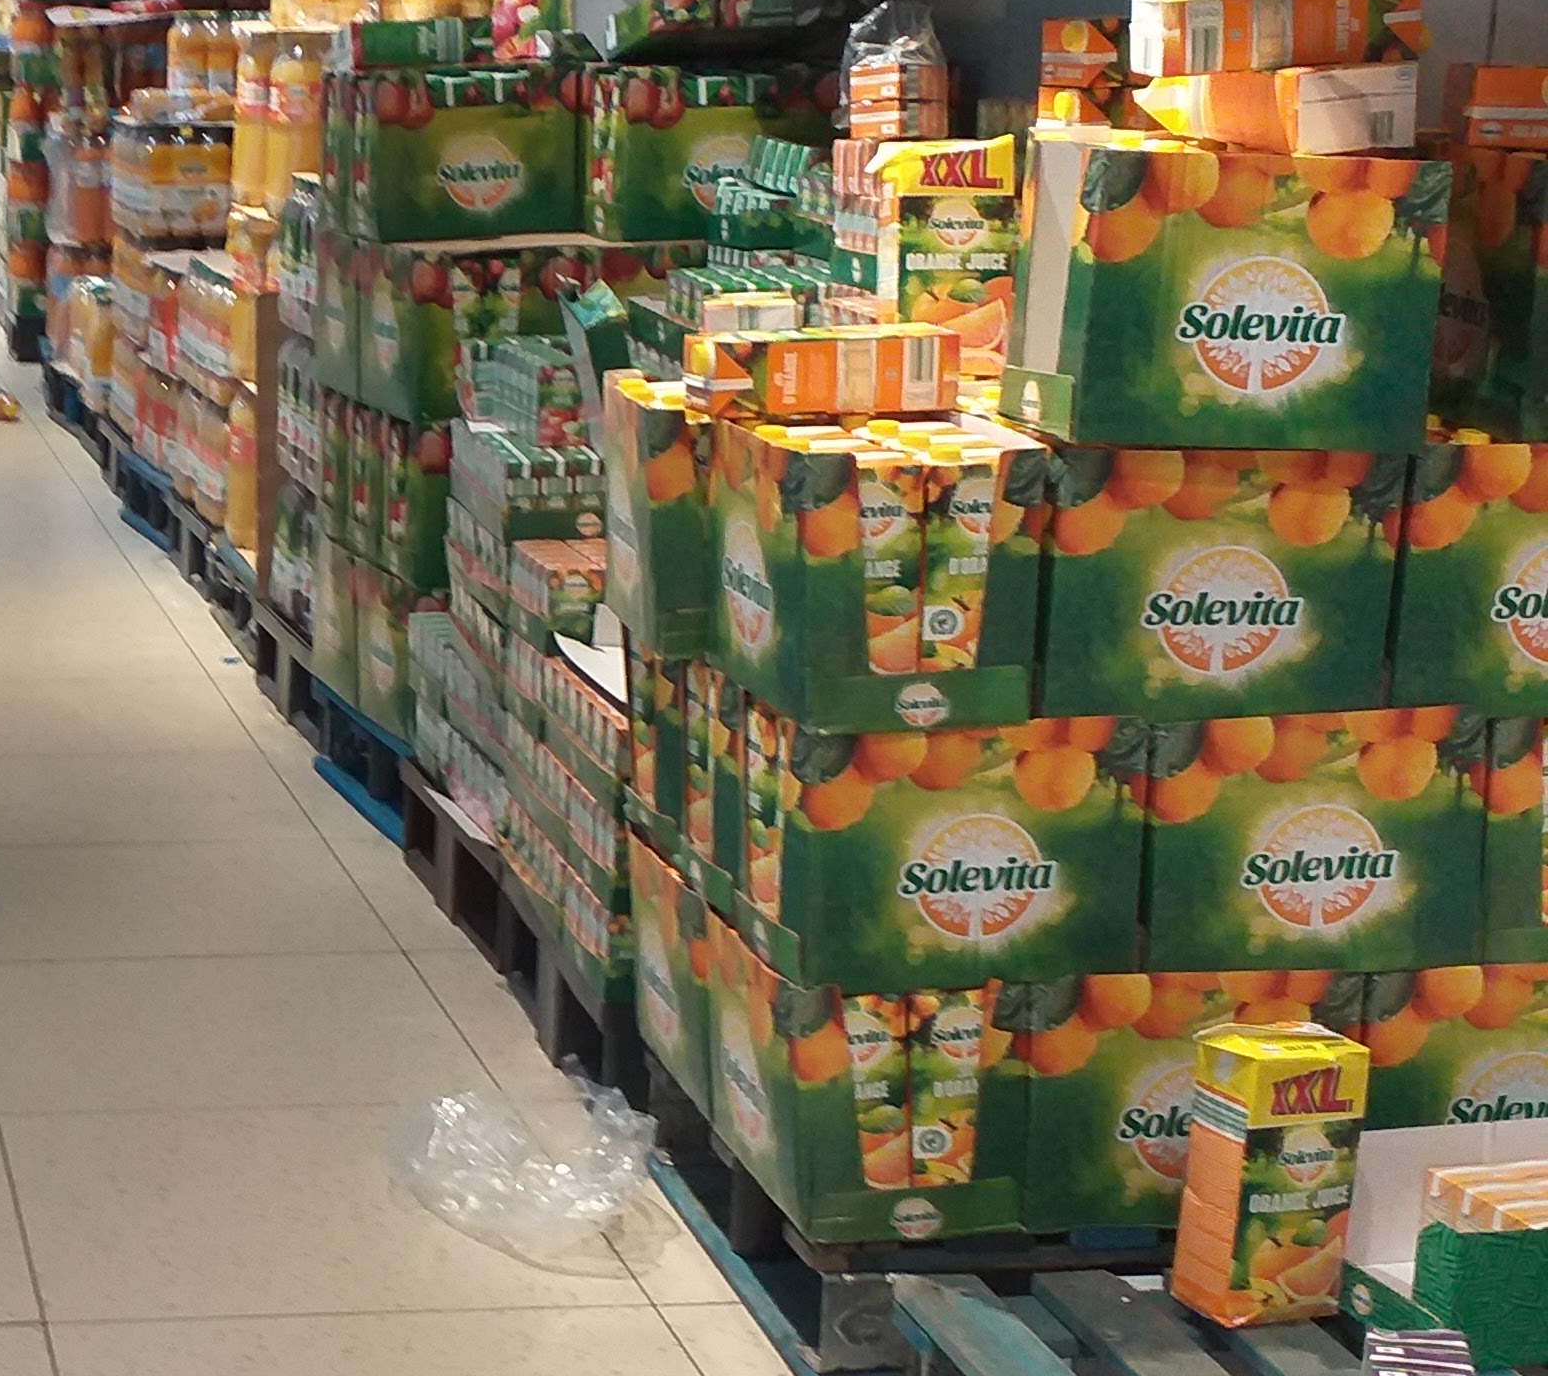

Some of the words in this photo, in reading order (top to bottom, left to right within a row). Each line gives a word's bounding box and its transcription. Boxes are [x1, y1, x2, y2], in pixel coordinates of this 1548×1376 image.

[920, 147, 1004, 189] XXL
[905, 252, 963, 271] ORANGE
[965, 252, 1008, 271] JUICE
[1179, 304, 1342, 344] Solevita
[1144, 590, 1301, 626] Solevita
[901, 856, 1054, 895] Solevita
[1243, 845, 1395, 886] Solevita
[1270, 1065, 1355, 1116] XXL
[1249, 1190, 1310, 1213] ORANGE
[1313, 1184, 1350, 1209] JUICE
